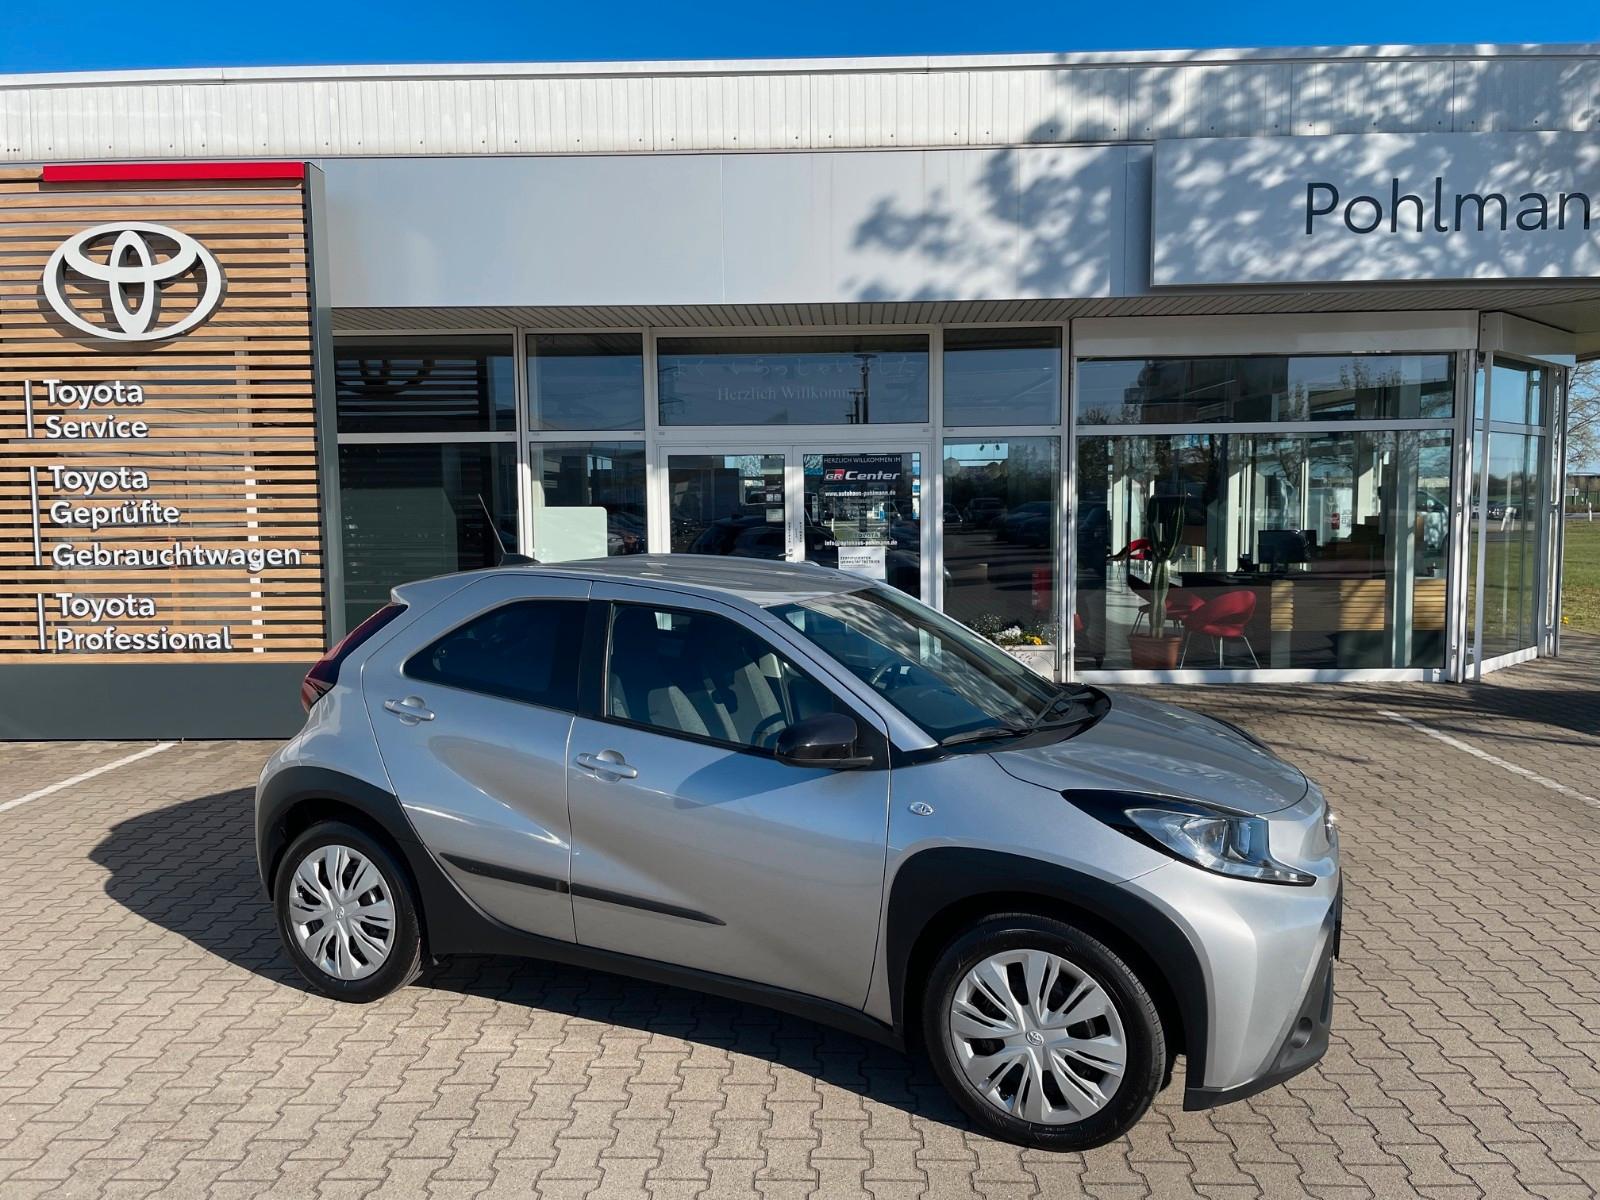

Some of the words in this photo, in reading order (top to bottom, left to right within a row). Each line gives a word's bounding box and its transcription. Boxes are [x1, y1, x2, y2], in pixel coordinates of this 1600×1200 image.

[1306, 176, 1591, 235] Pohlman
[43, 378, 143, 408] Toyota
[718, 387, 776, 401] Herzlich
[783, 385, 869, 401] Willkomm
[45, 415, 148, 438] Service
[48, 465, 149, 495] Toyota
[845, 471, 900, 480] Center
[50, 500, 180, 529] Geprüfte
[52, 543, 301, 571] Gebrauchtwagen
[55, 592, 156, 622] Toyota
[56, 626, 232, 651] Professional
